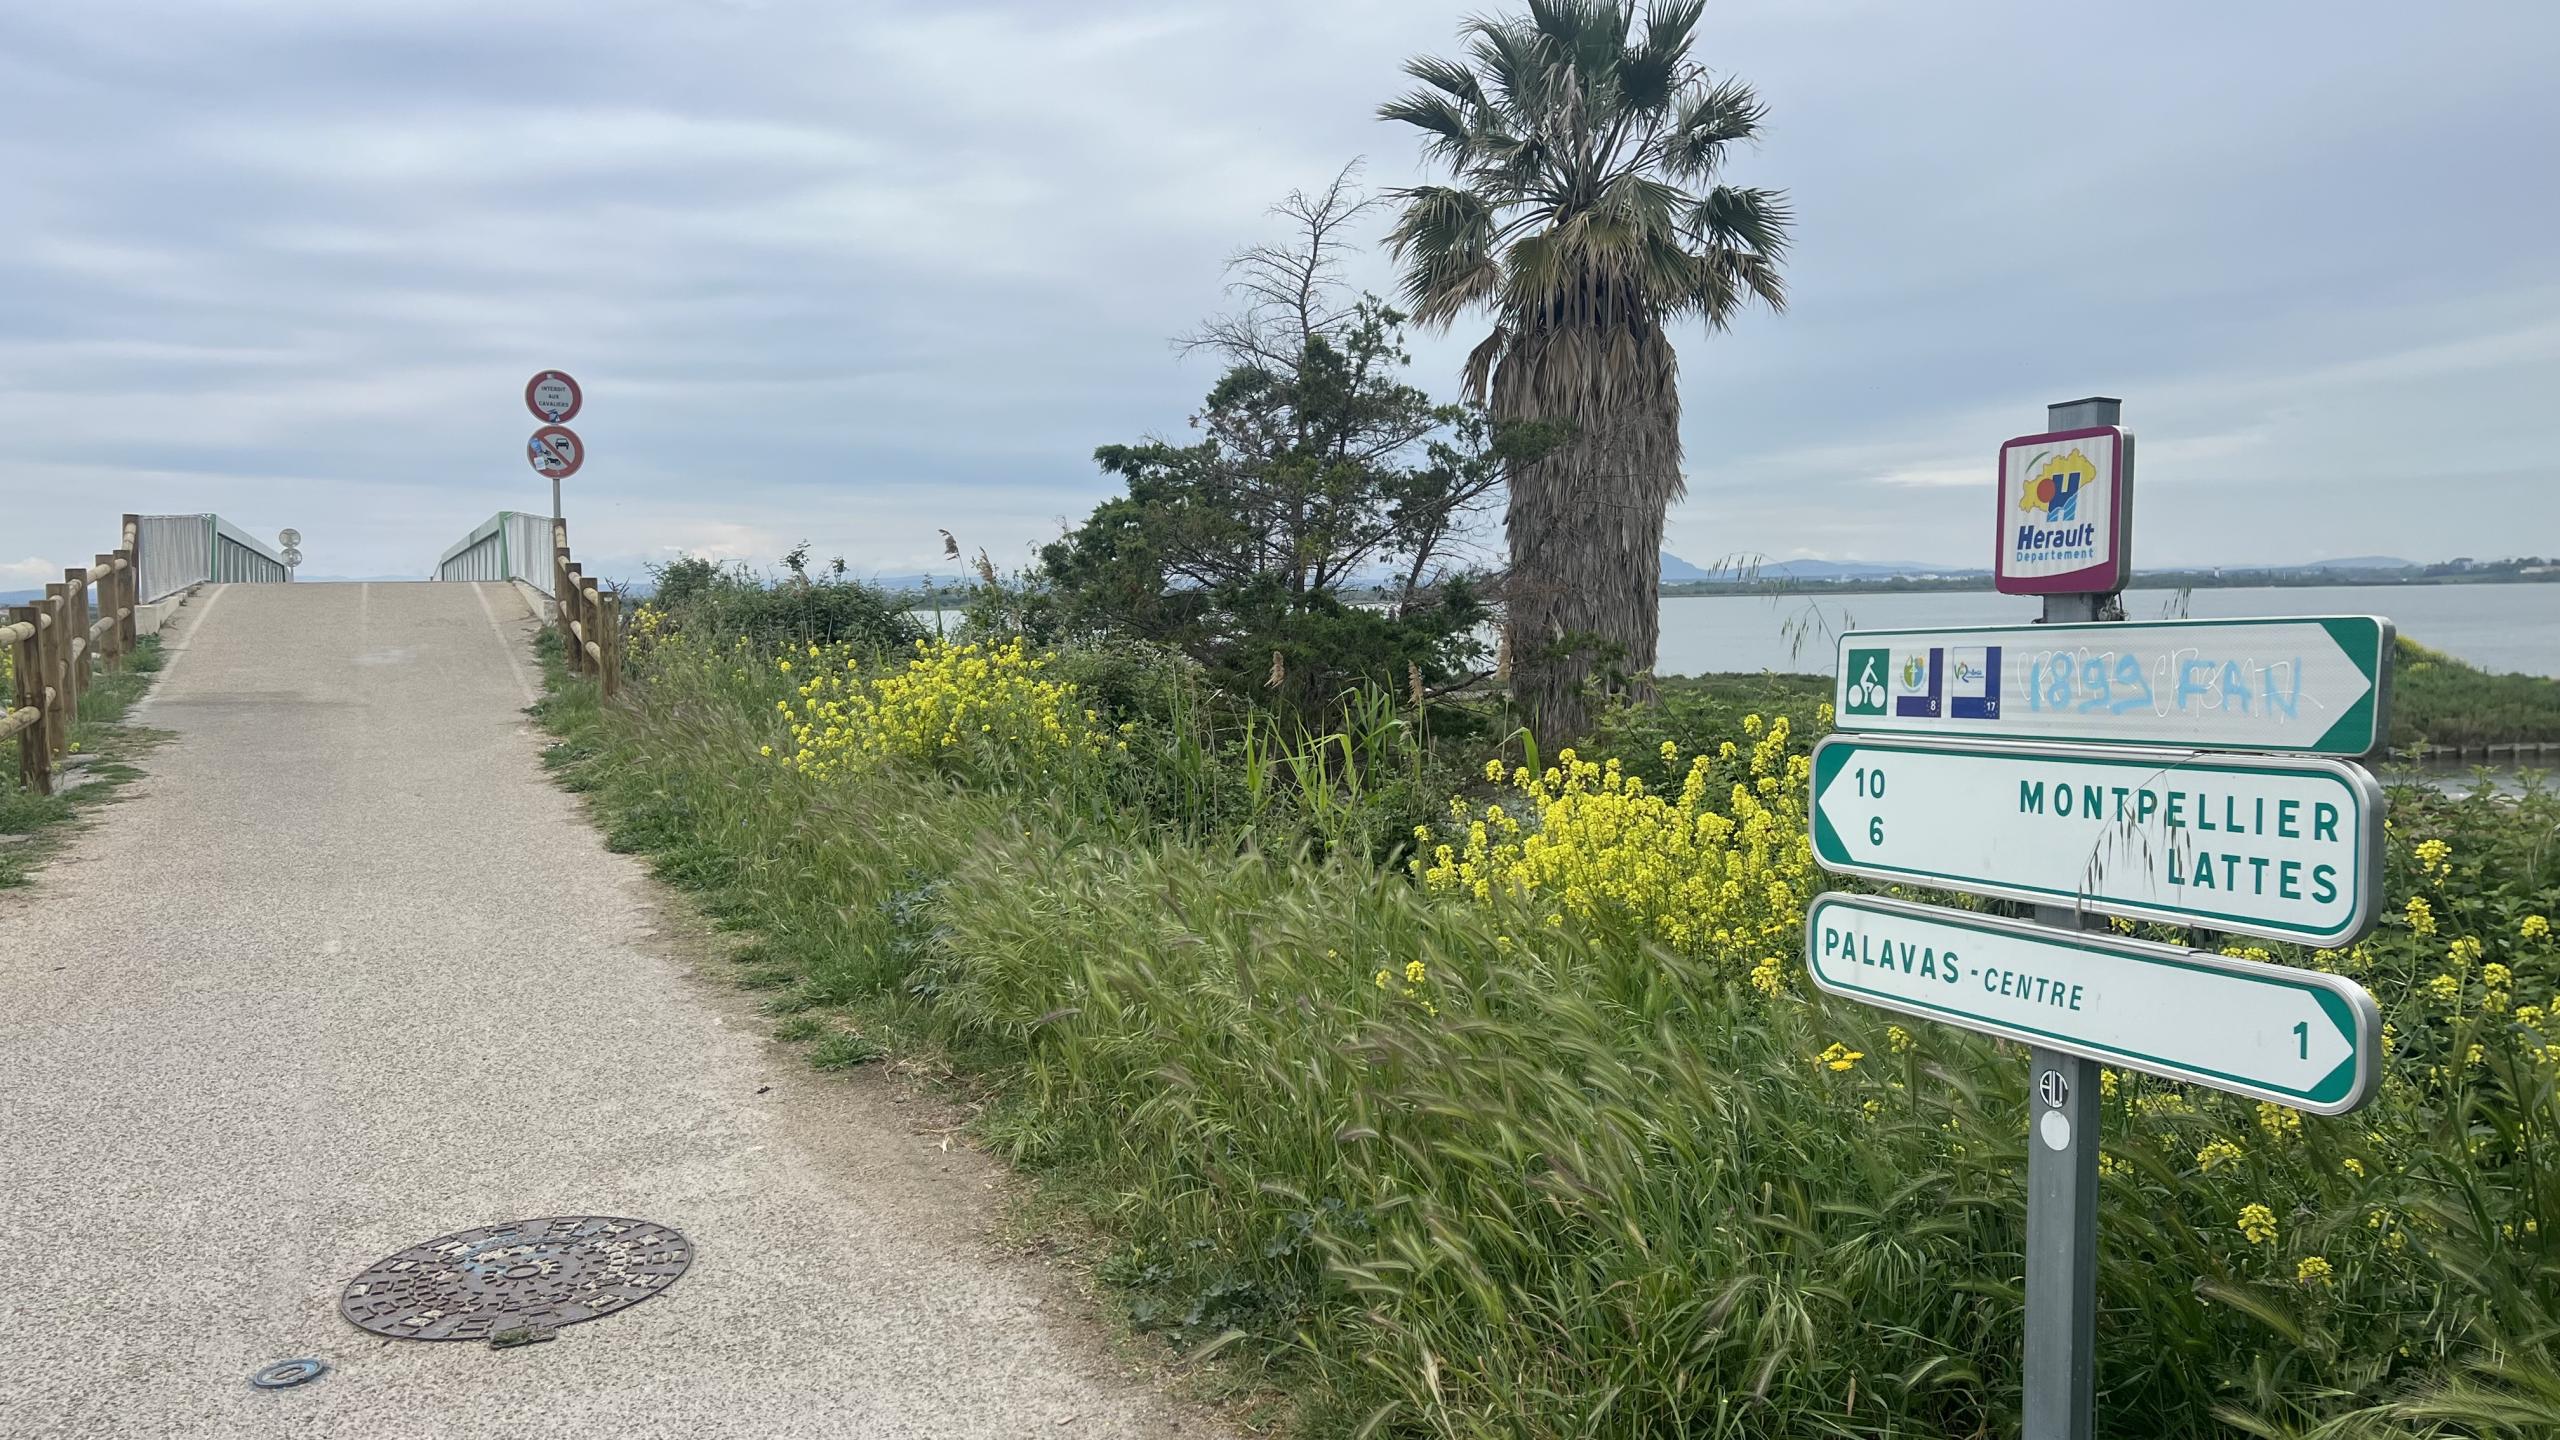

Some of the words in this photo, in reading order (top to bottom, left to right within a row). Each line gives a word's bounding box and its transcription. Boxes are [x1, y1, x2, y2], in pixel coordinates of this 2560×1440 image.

[1930, 700, 1936, 711] 8
[1986, 701, 1996, 711] 17
[1855, 767, 1886, 799] 10
[2020, 779, 2339, 843] MONTPELLIER
[1869, 816, 1884, 846] 6
[2168, 848, 2338, 904] LATTES
[2293, 1021, 2308, 1060] 1
